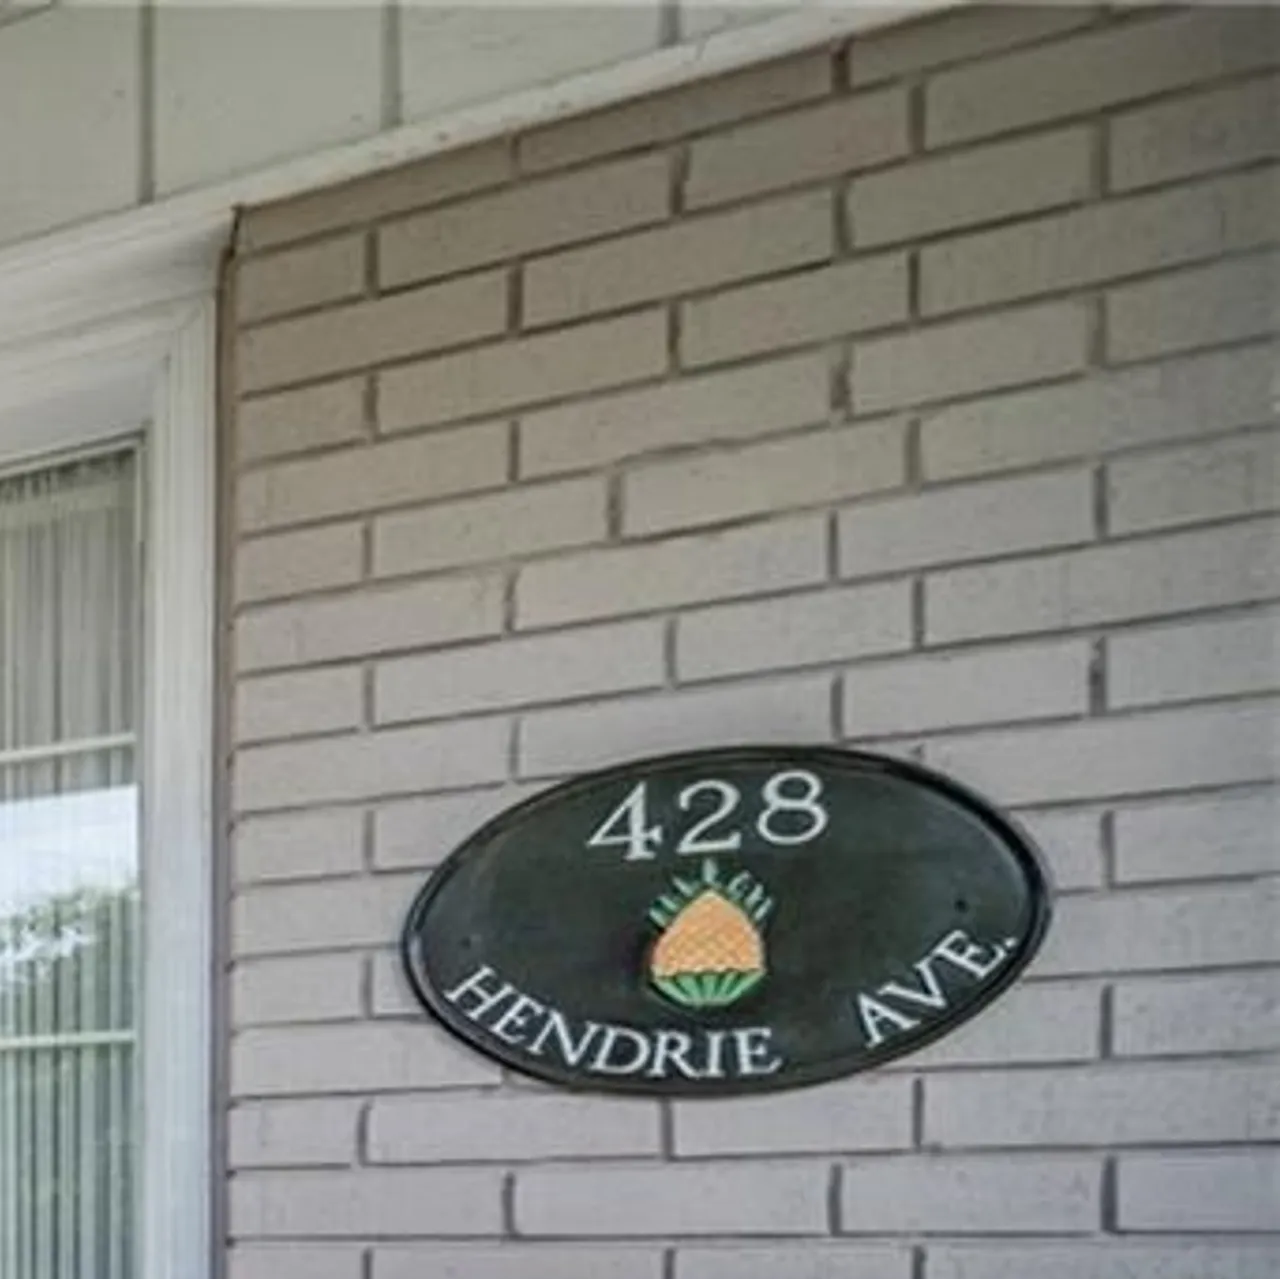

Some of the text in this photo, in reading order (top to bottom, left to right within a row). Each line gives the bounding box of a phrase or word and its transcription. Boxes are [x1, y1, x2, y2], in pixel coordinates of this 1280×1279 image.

[587, 769, 829, 861] 428
[444, 928, 1020, 1079] HENDRIE AVE.
